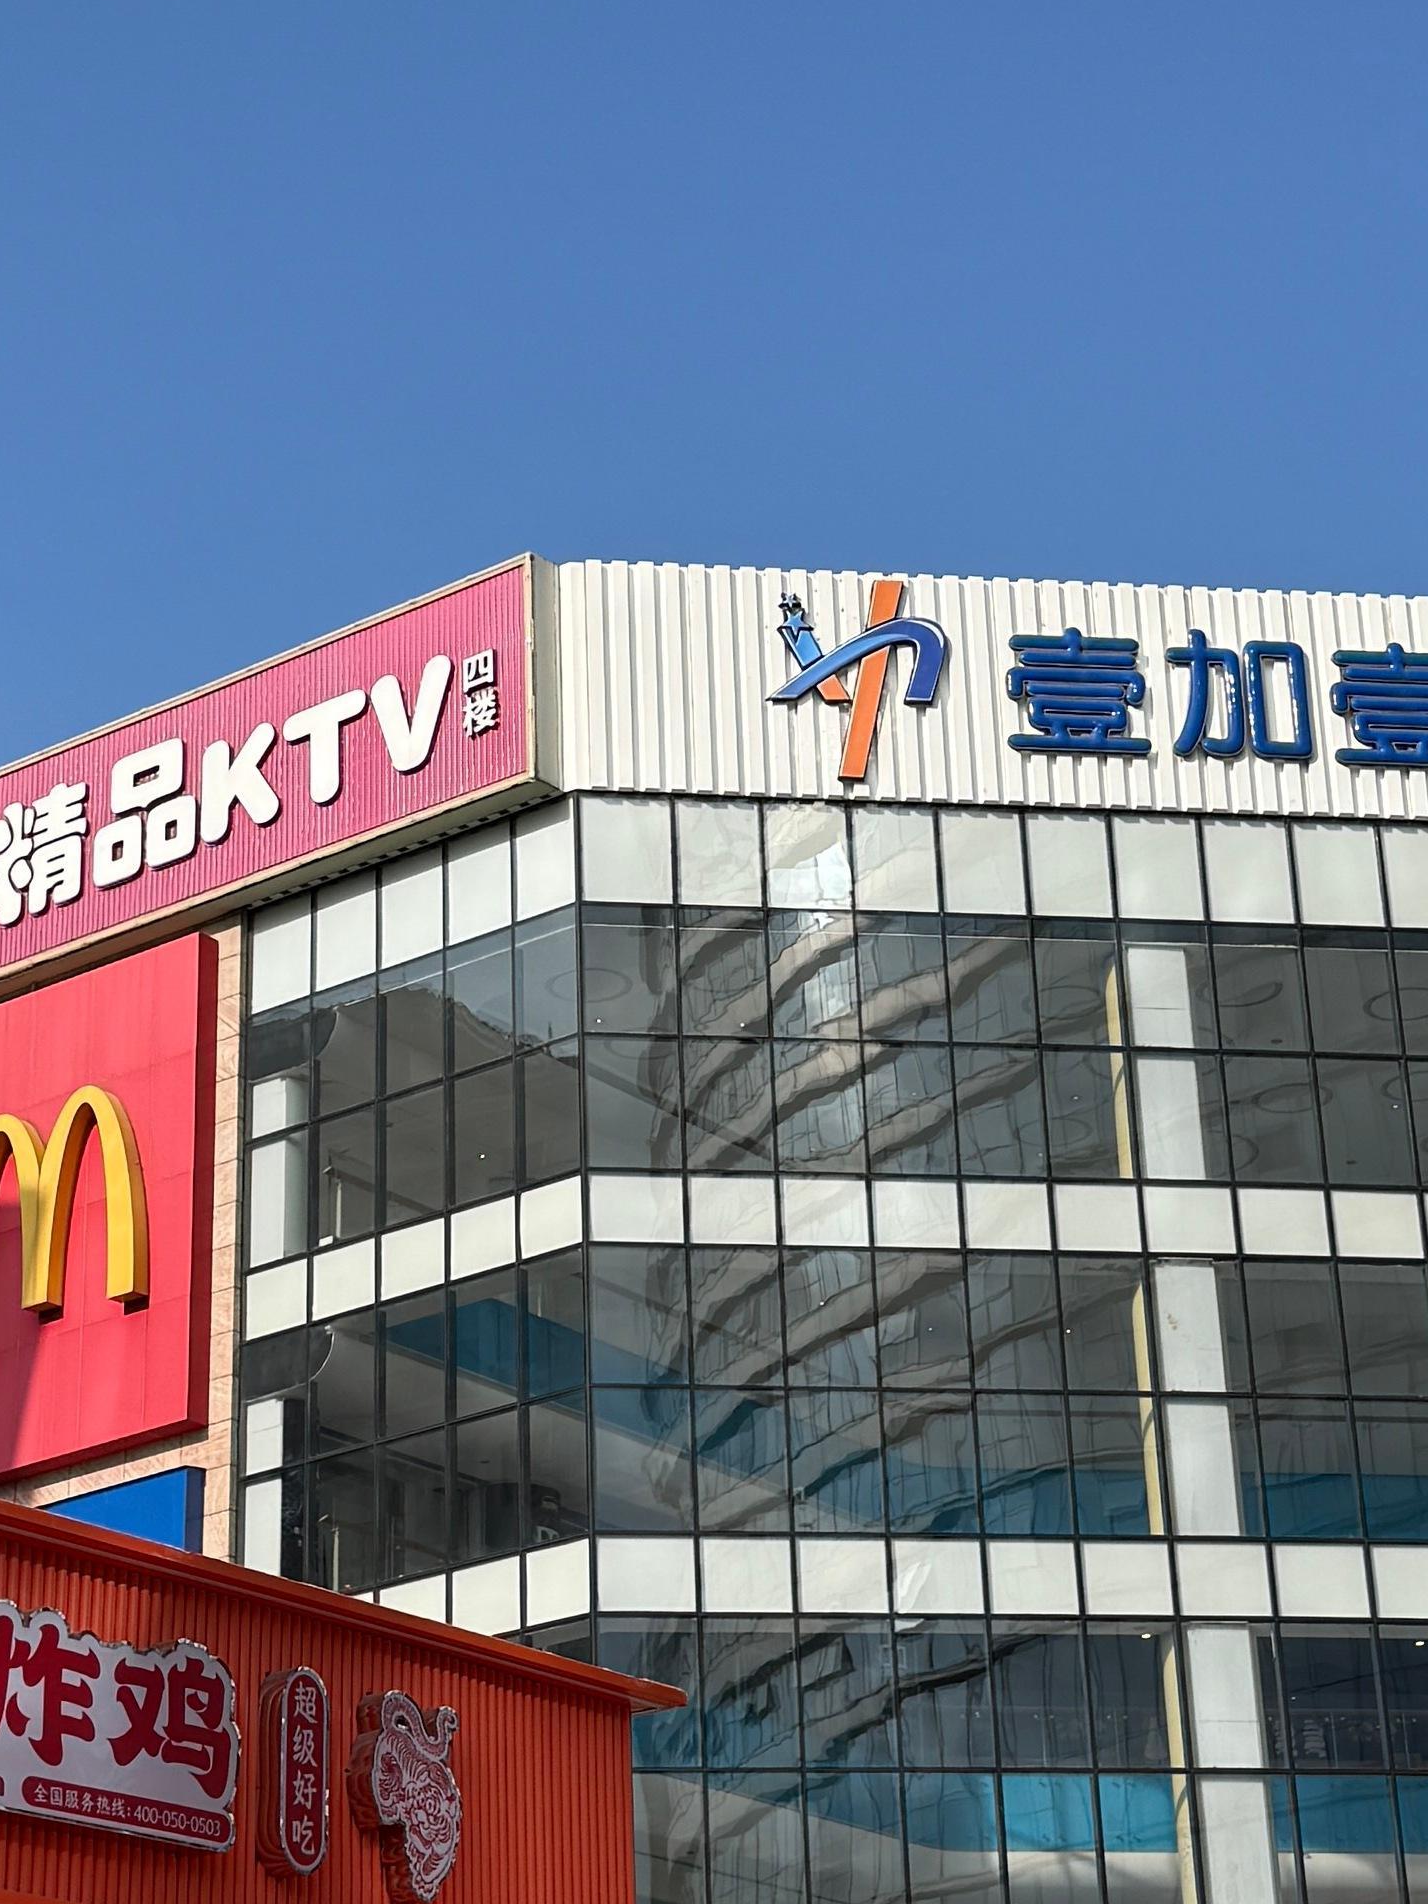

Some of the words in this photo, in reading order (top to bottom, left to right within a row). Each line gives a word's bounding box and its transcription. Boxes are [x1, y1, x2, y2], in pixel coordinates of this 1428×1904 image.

[462, 648, 500, 738] 四楼
[291, 1681, 319, 1857] 超级好吃
